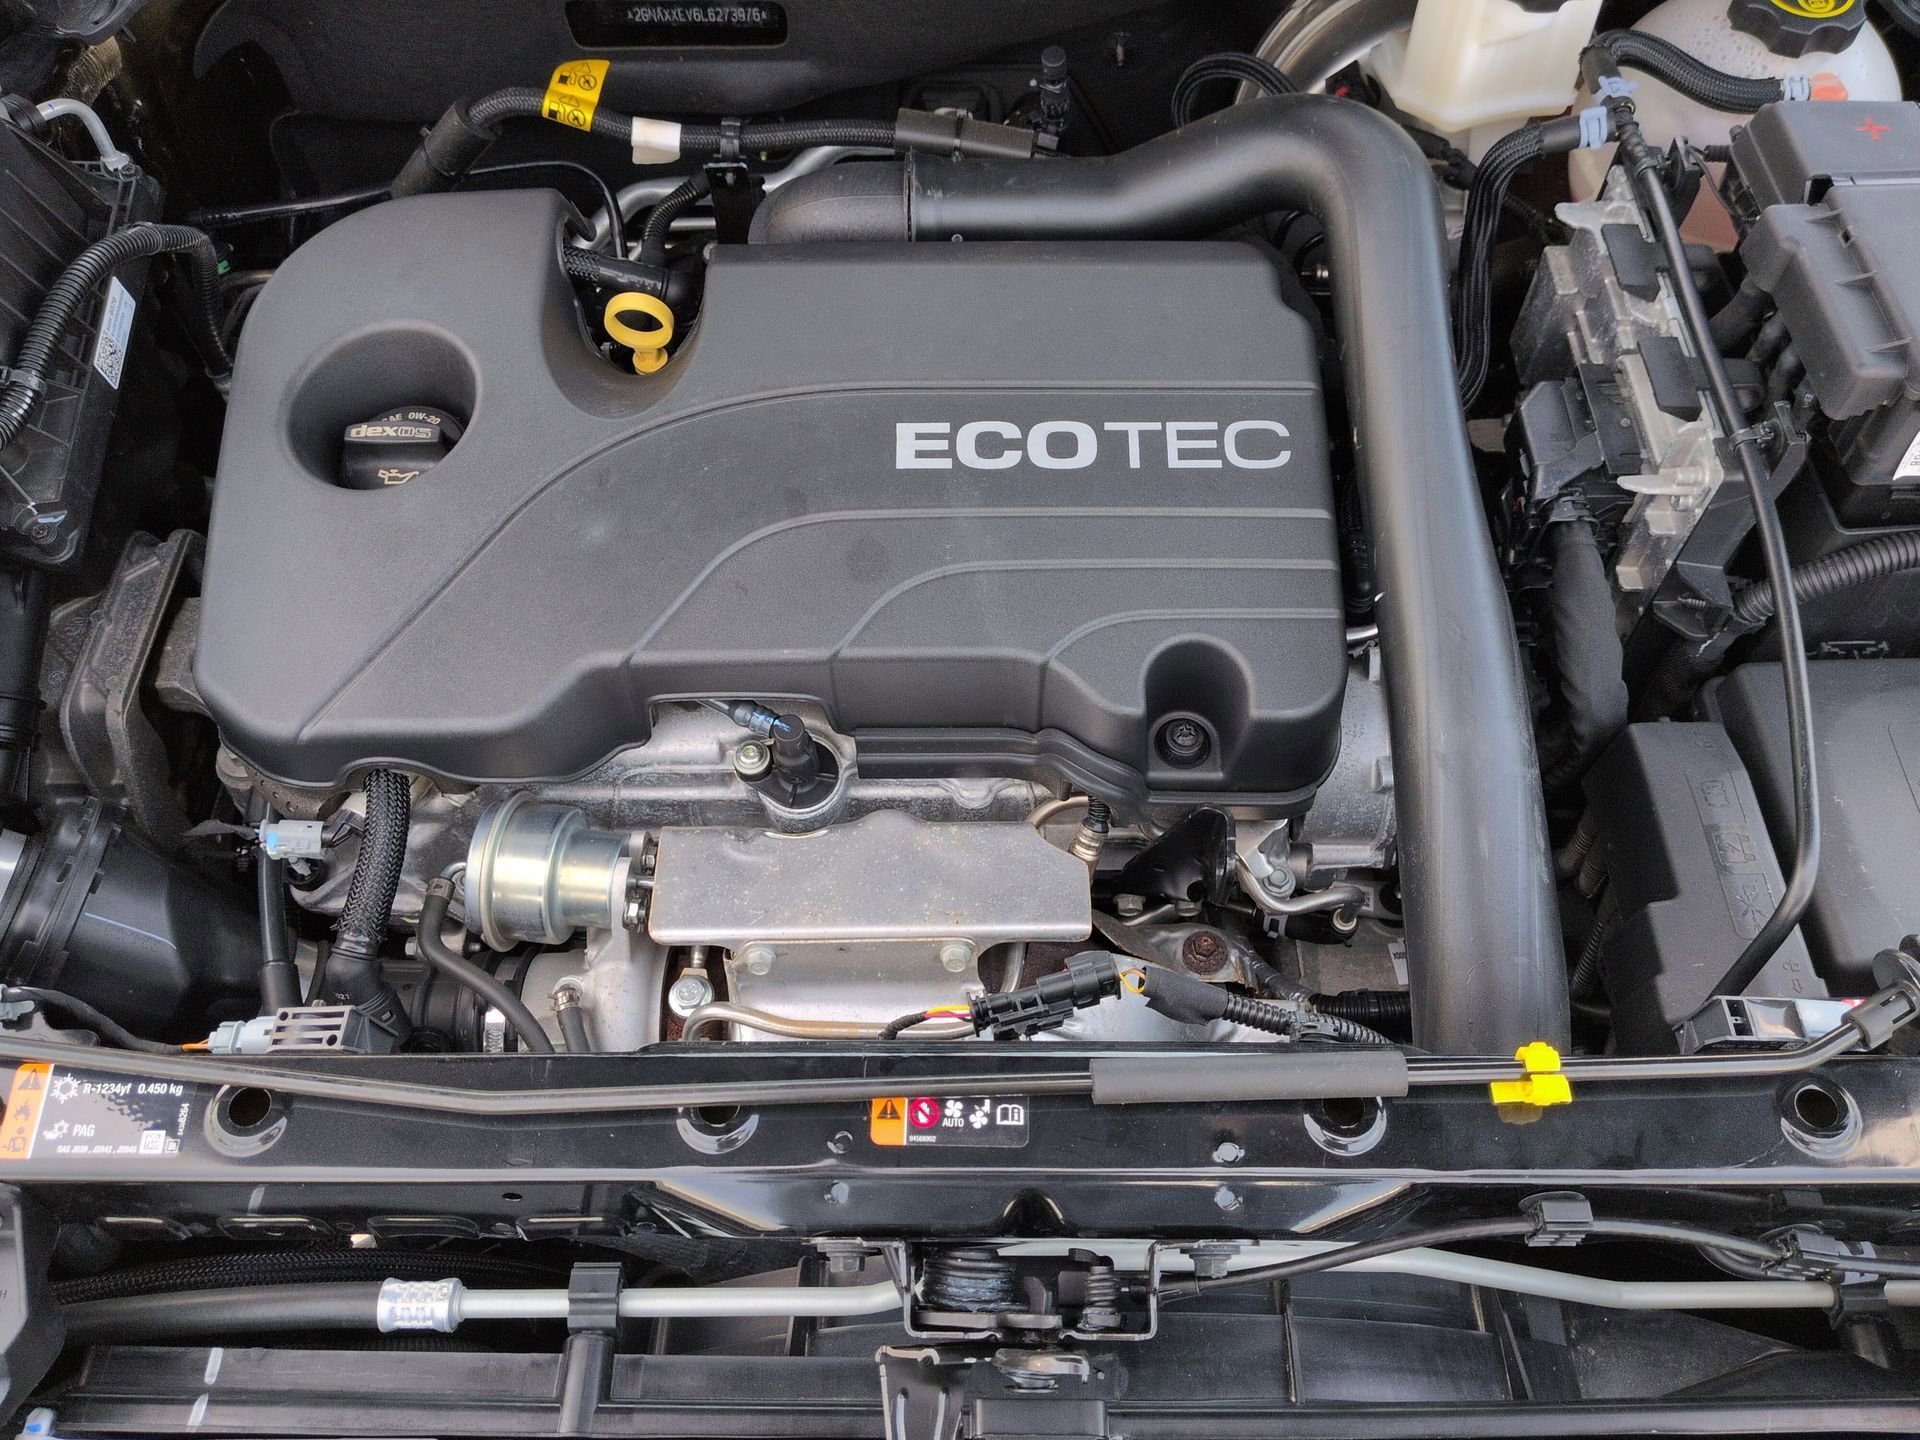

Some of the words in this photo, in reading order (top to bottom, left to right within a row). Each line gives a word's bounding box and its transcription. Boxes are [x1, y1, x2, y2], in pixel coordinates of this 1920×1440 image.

[408, 412, 441, 425] 0W-20
[350, 424, 432, 438] dexos
[896, 420, 1292, 469] ECOTEC
[83, 1083, 131, 1095] R-1234yf
[137, 1083, 168, 1095] 0.450
[169, 1083, 184, 1097] kg
[942, 1118, 965, 1127] AUTO
[72, 1123, 96, 1137] PAG
[57, 1144, 71, 1153] SAE
